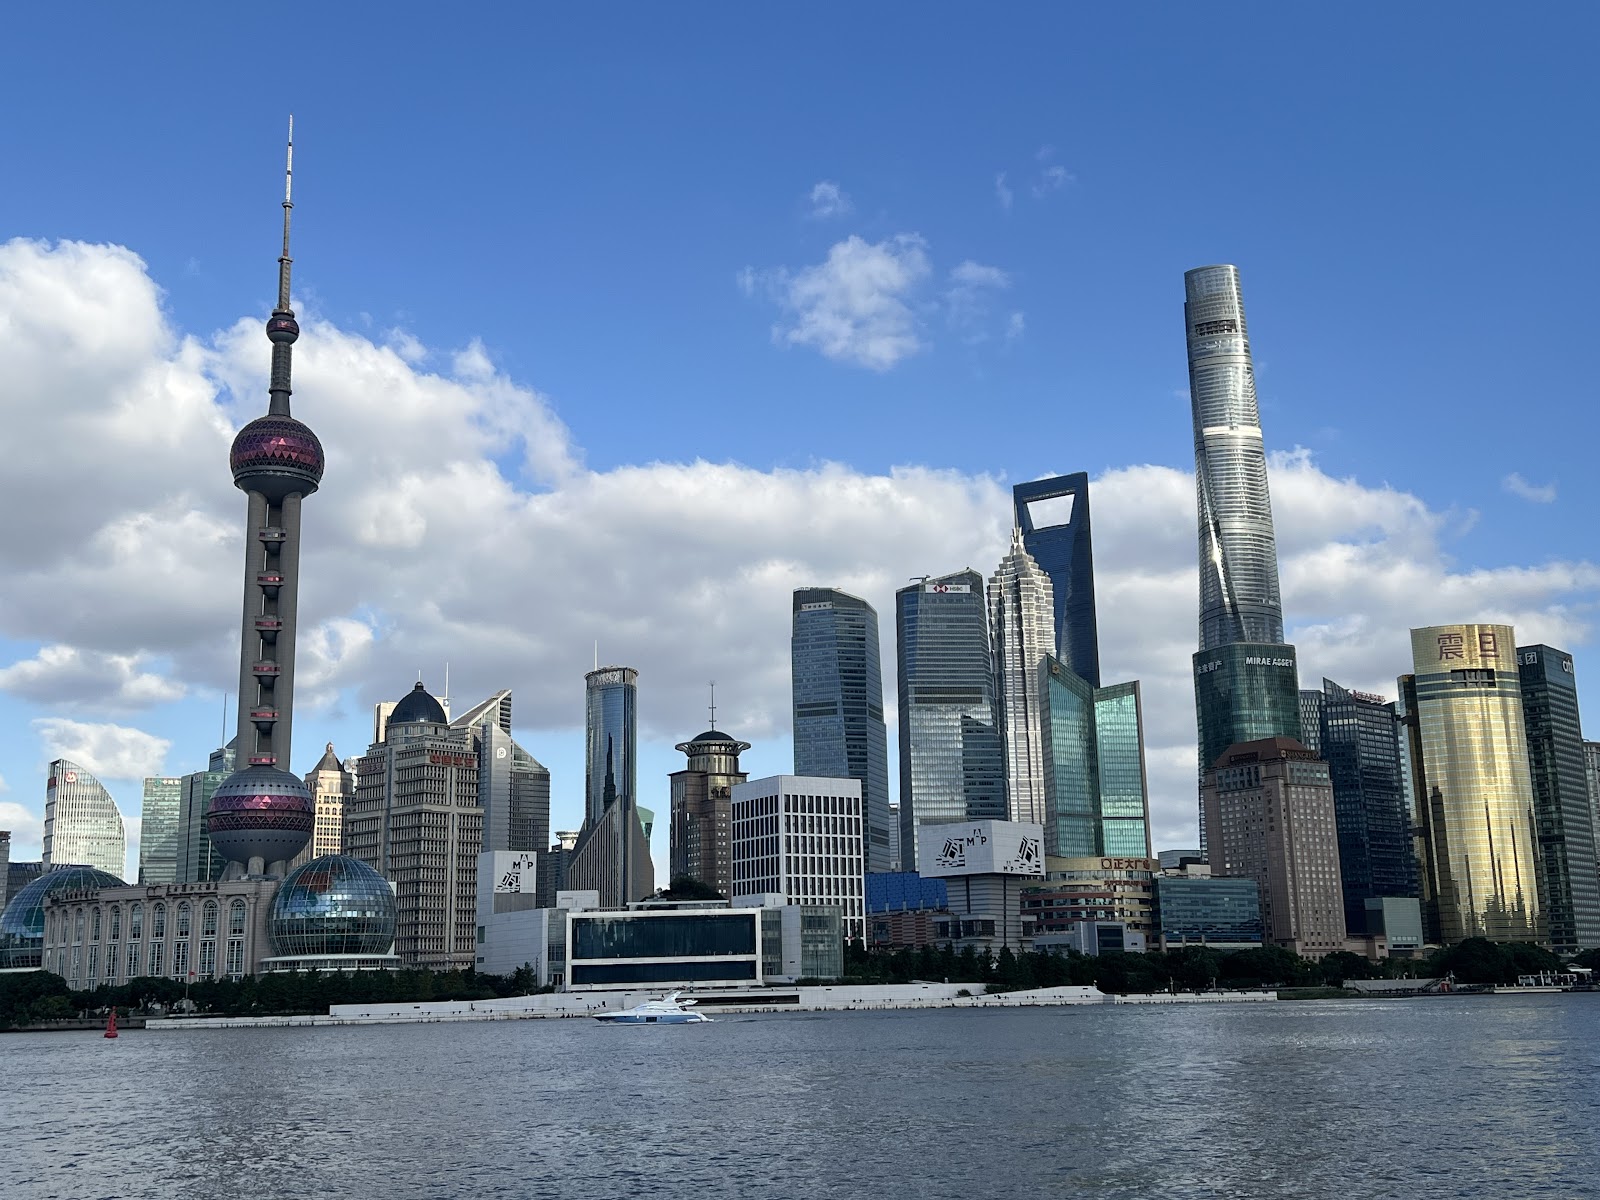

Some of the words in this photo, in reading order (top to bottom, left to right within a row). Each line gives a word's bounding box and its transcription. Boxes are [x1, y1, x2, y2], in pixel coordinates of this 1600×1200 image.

[1437, 633, 1500, 660] 震旦
[1245, 656, 1271, 666] MIRAE
[1272, 658, 1293, 667] ASSET
[1562, 658, 1574, 673] citi
